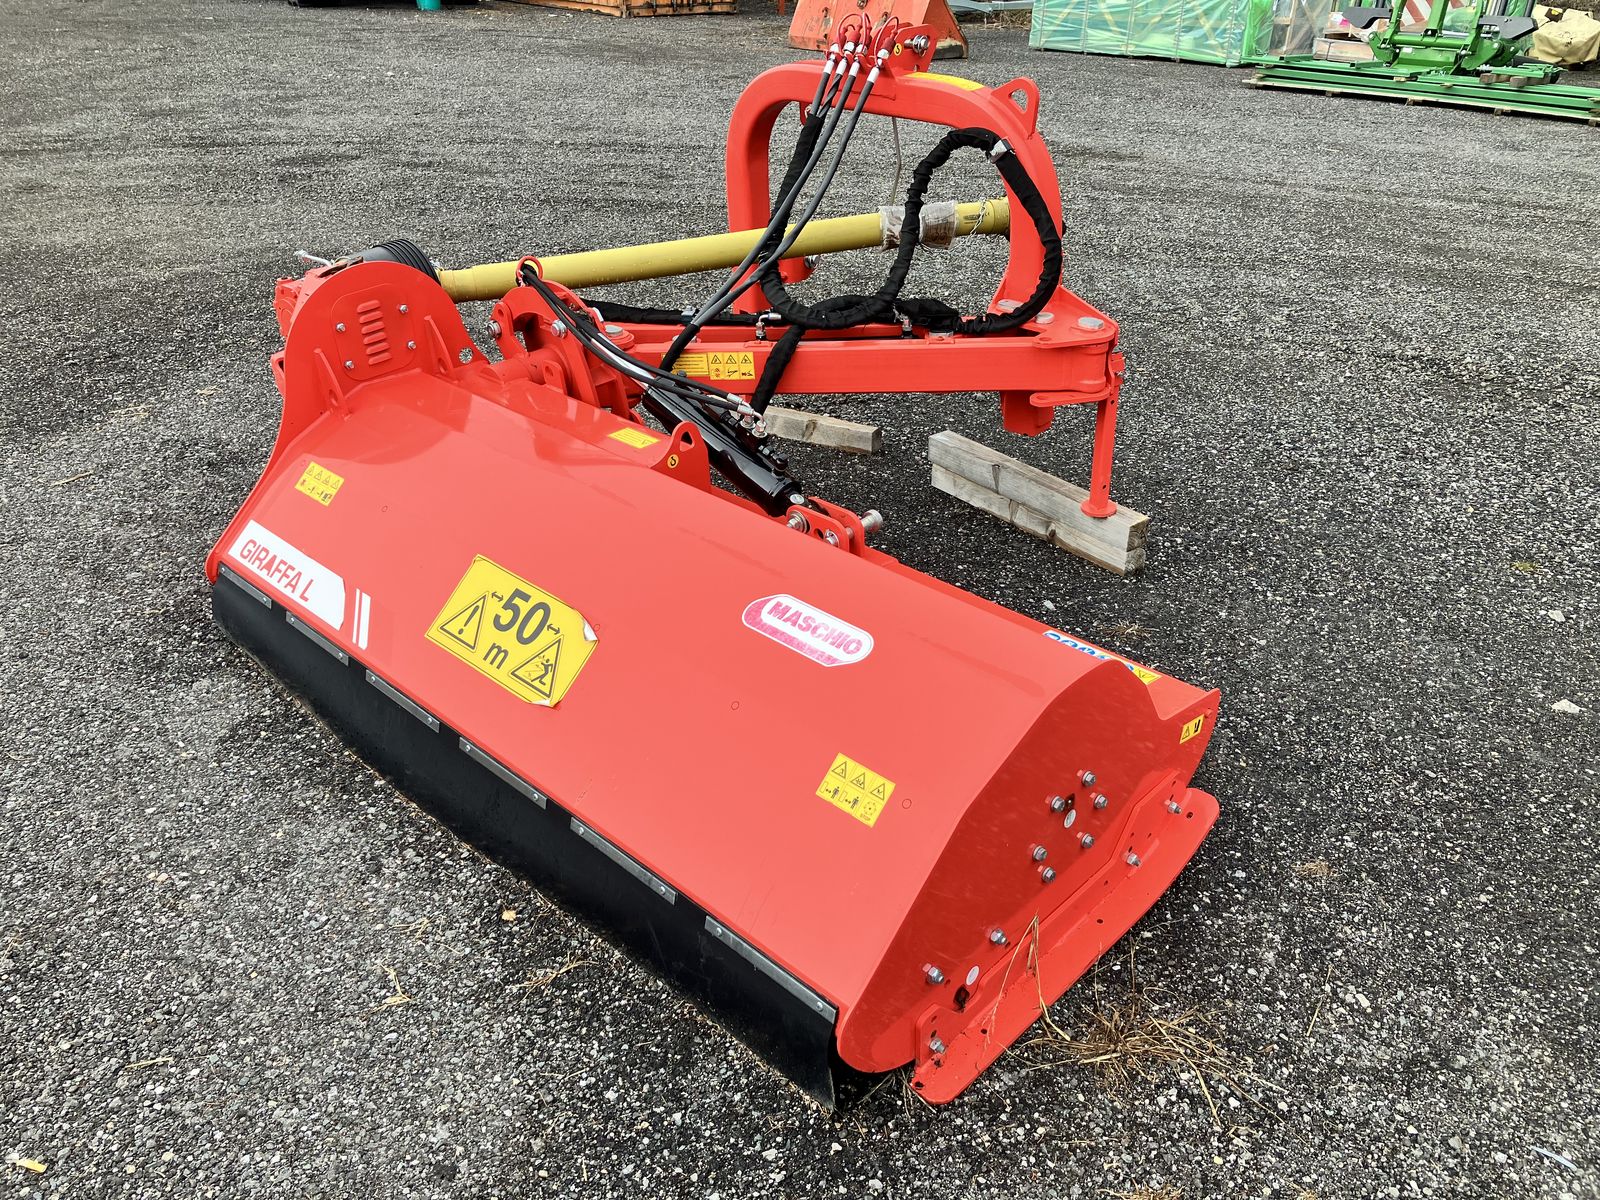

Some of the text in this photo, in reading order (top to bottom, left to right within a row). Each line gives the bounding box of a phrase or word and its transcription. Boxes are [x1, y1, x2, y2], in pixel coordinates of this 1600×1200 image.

[239, 538, 314, 602] GIRAFFA L
[493, 587, 551, 645] 50
[767, 600, 863, 655] MASCHIO
[482, 642, 509, 670] m
